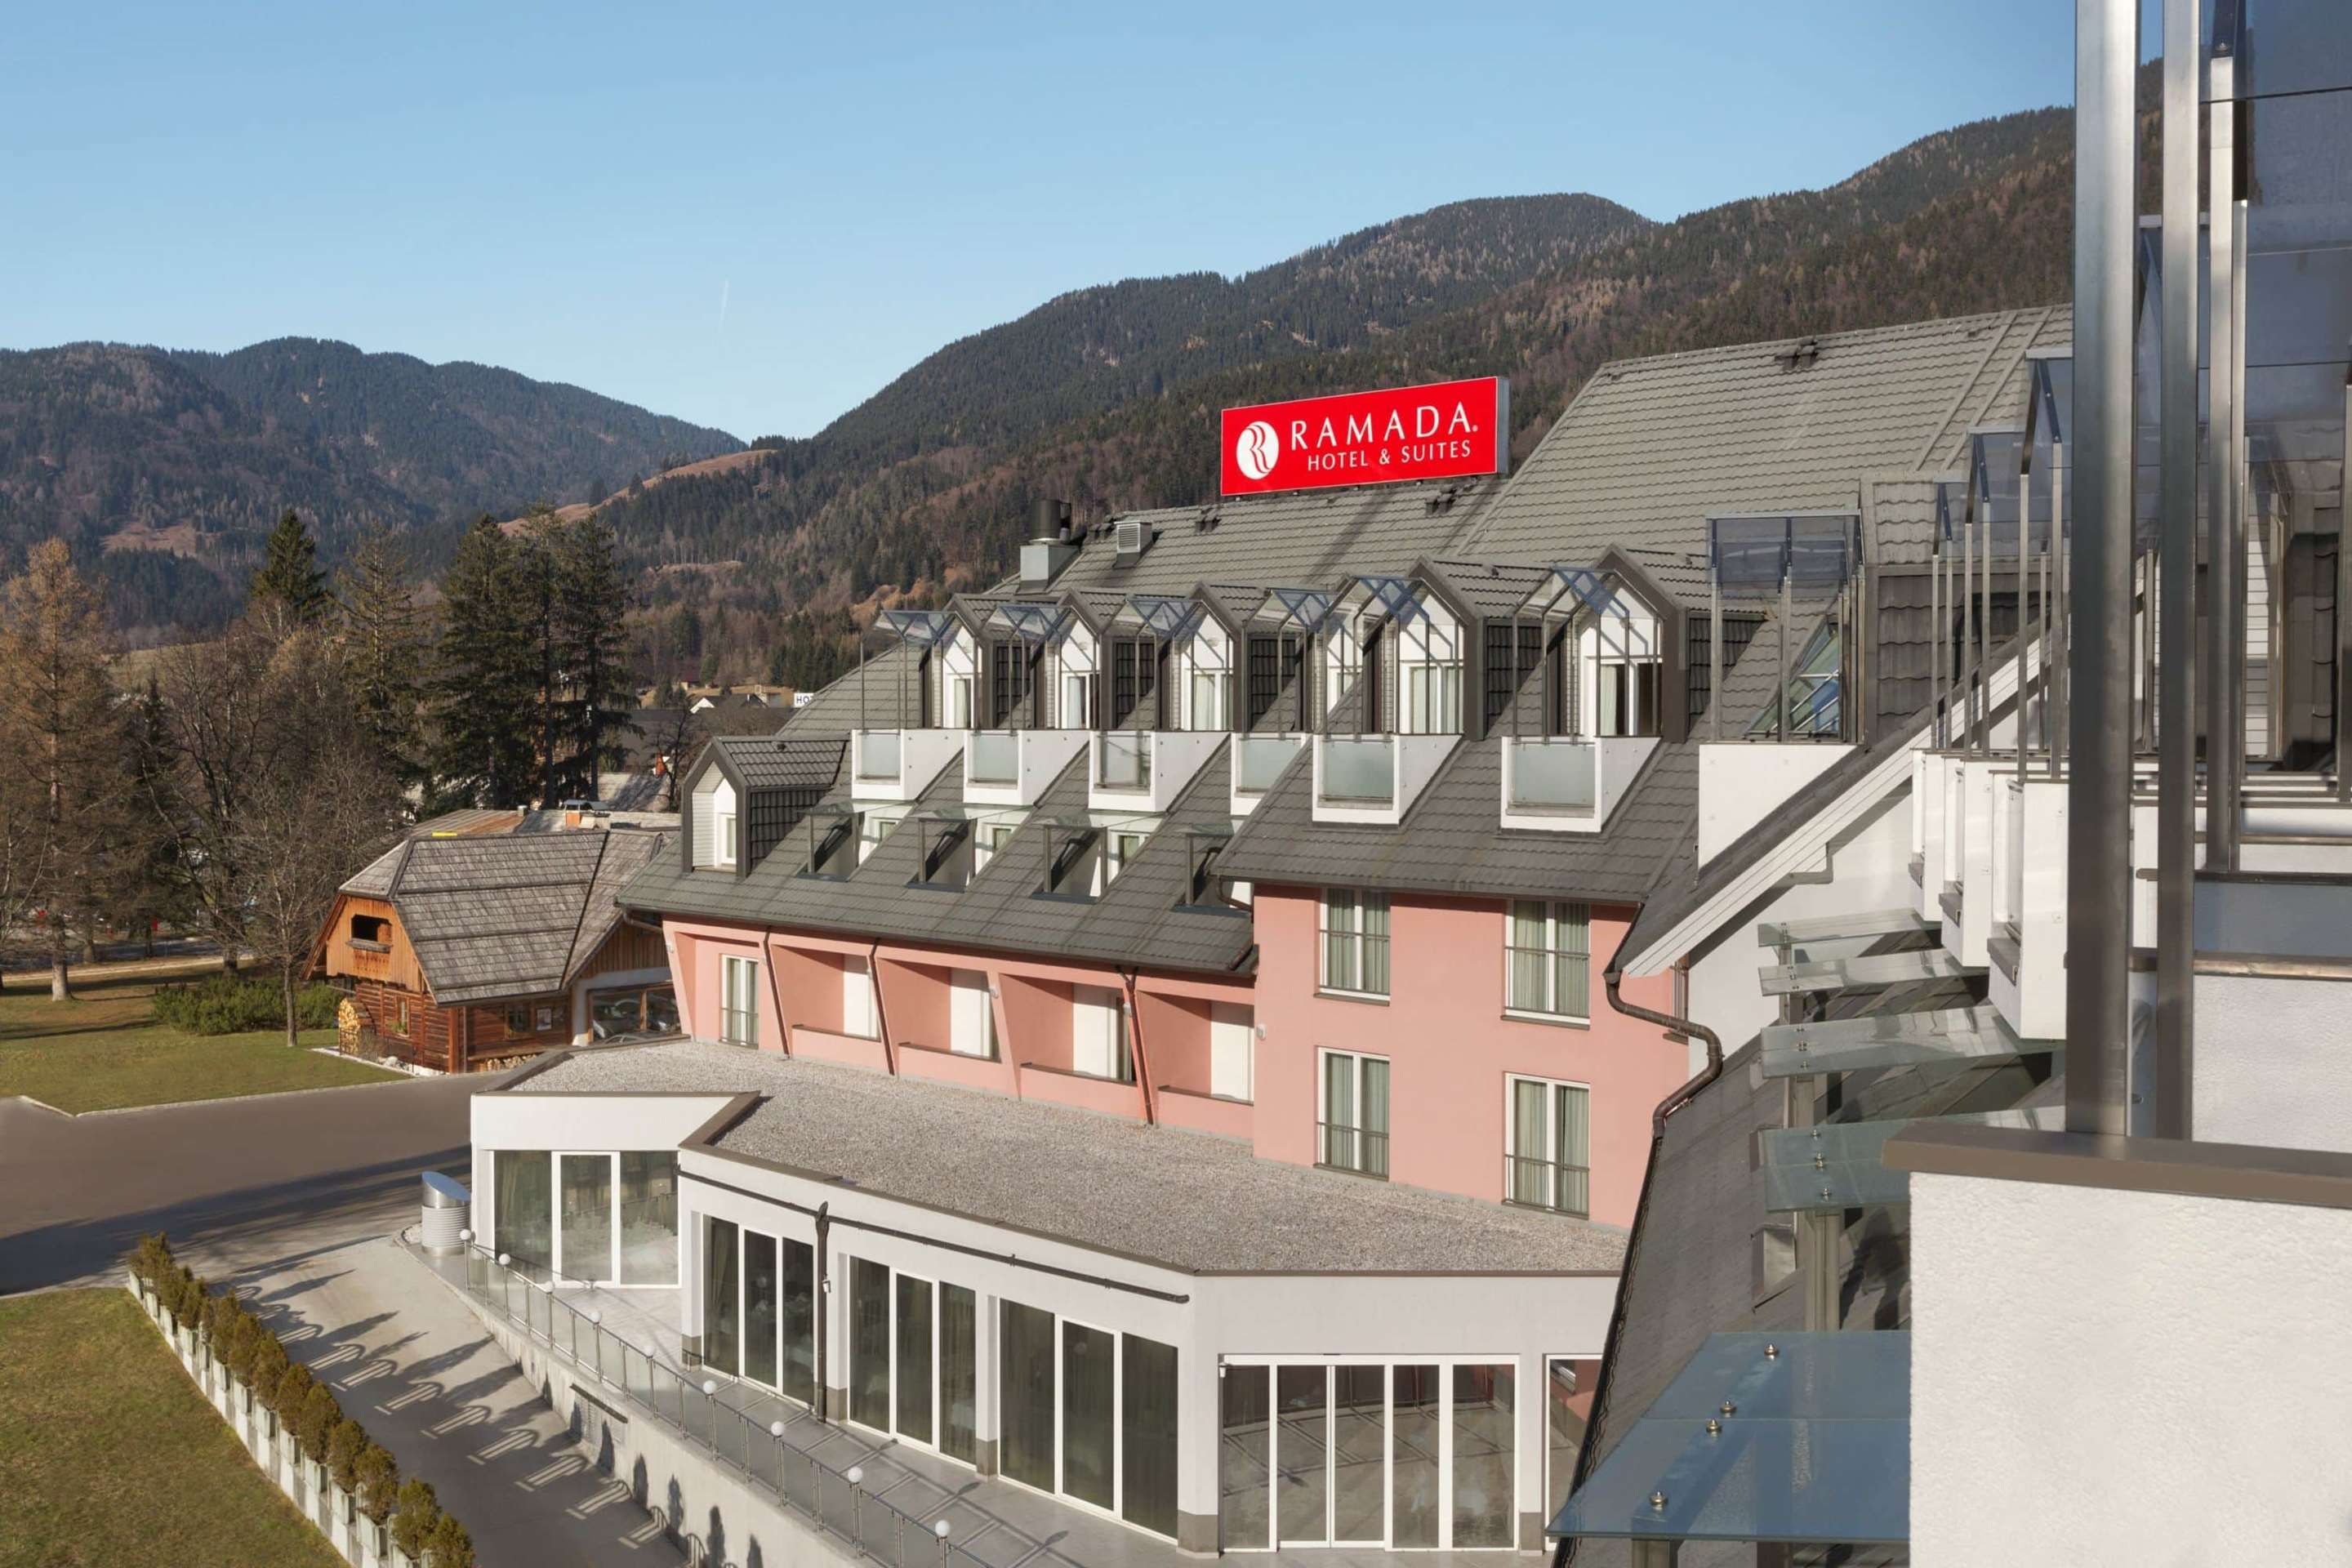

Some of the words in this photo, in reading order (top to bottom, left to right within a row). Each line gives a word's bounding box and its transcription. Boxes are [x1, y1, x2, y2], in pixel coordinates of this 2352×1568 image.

[1307, 451, 1369, 471] HOTEL
[1379, 448, 1390, 465] &
[1401, 439, 1471, 463] SUITES
[796, 695, 813, 705] HO
